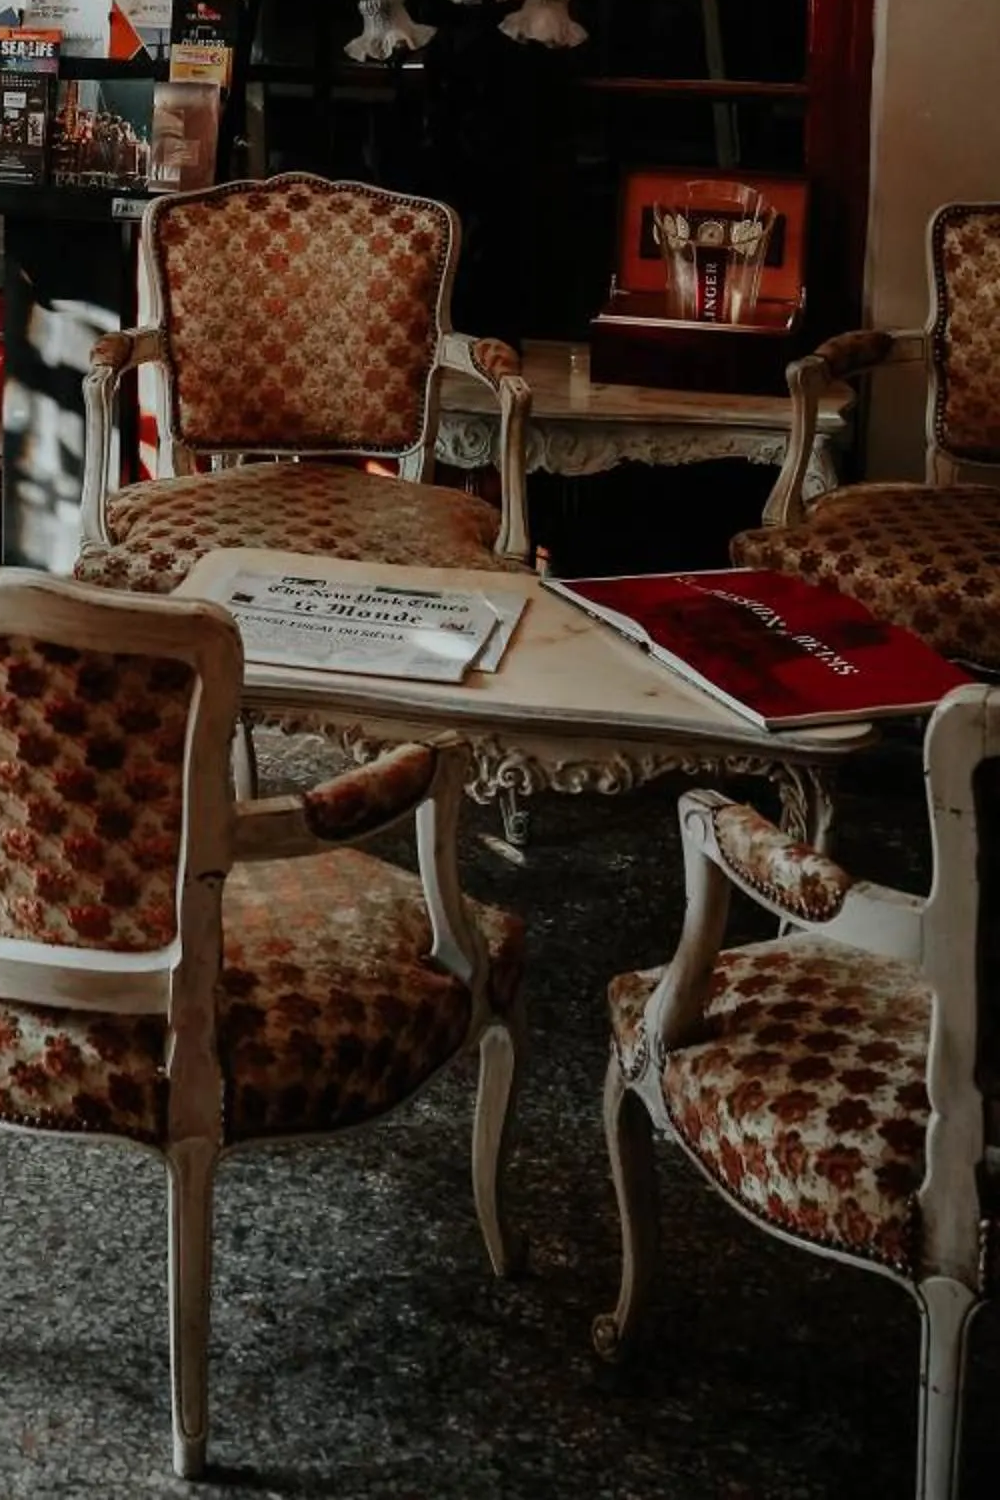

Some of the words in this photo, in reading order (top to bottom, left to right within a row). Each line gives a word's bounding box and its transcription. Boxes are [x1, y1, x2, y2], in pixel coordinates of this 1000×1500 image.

[1, 41, 25, 55] SEA
[703, 262, 718, 323] INGER
[268, 585, 304, 596] The
[309, 589, 351, 599] New
[355, 593, 402, 605] York
[407, 600, 469, 612] Times
[294, 600, 318, 612] Le
[326, 602, 423, 624] Monde
